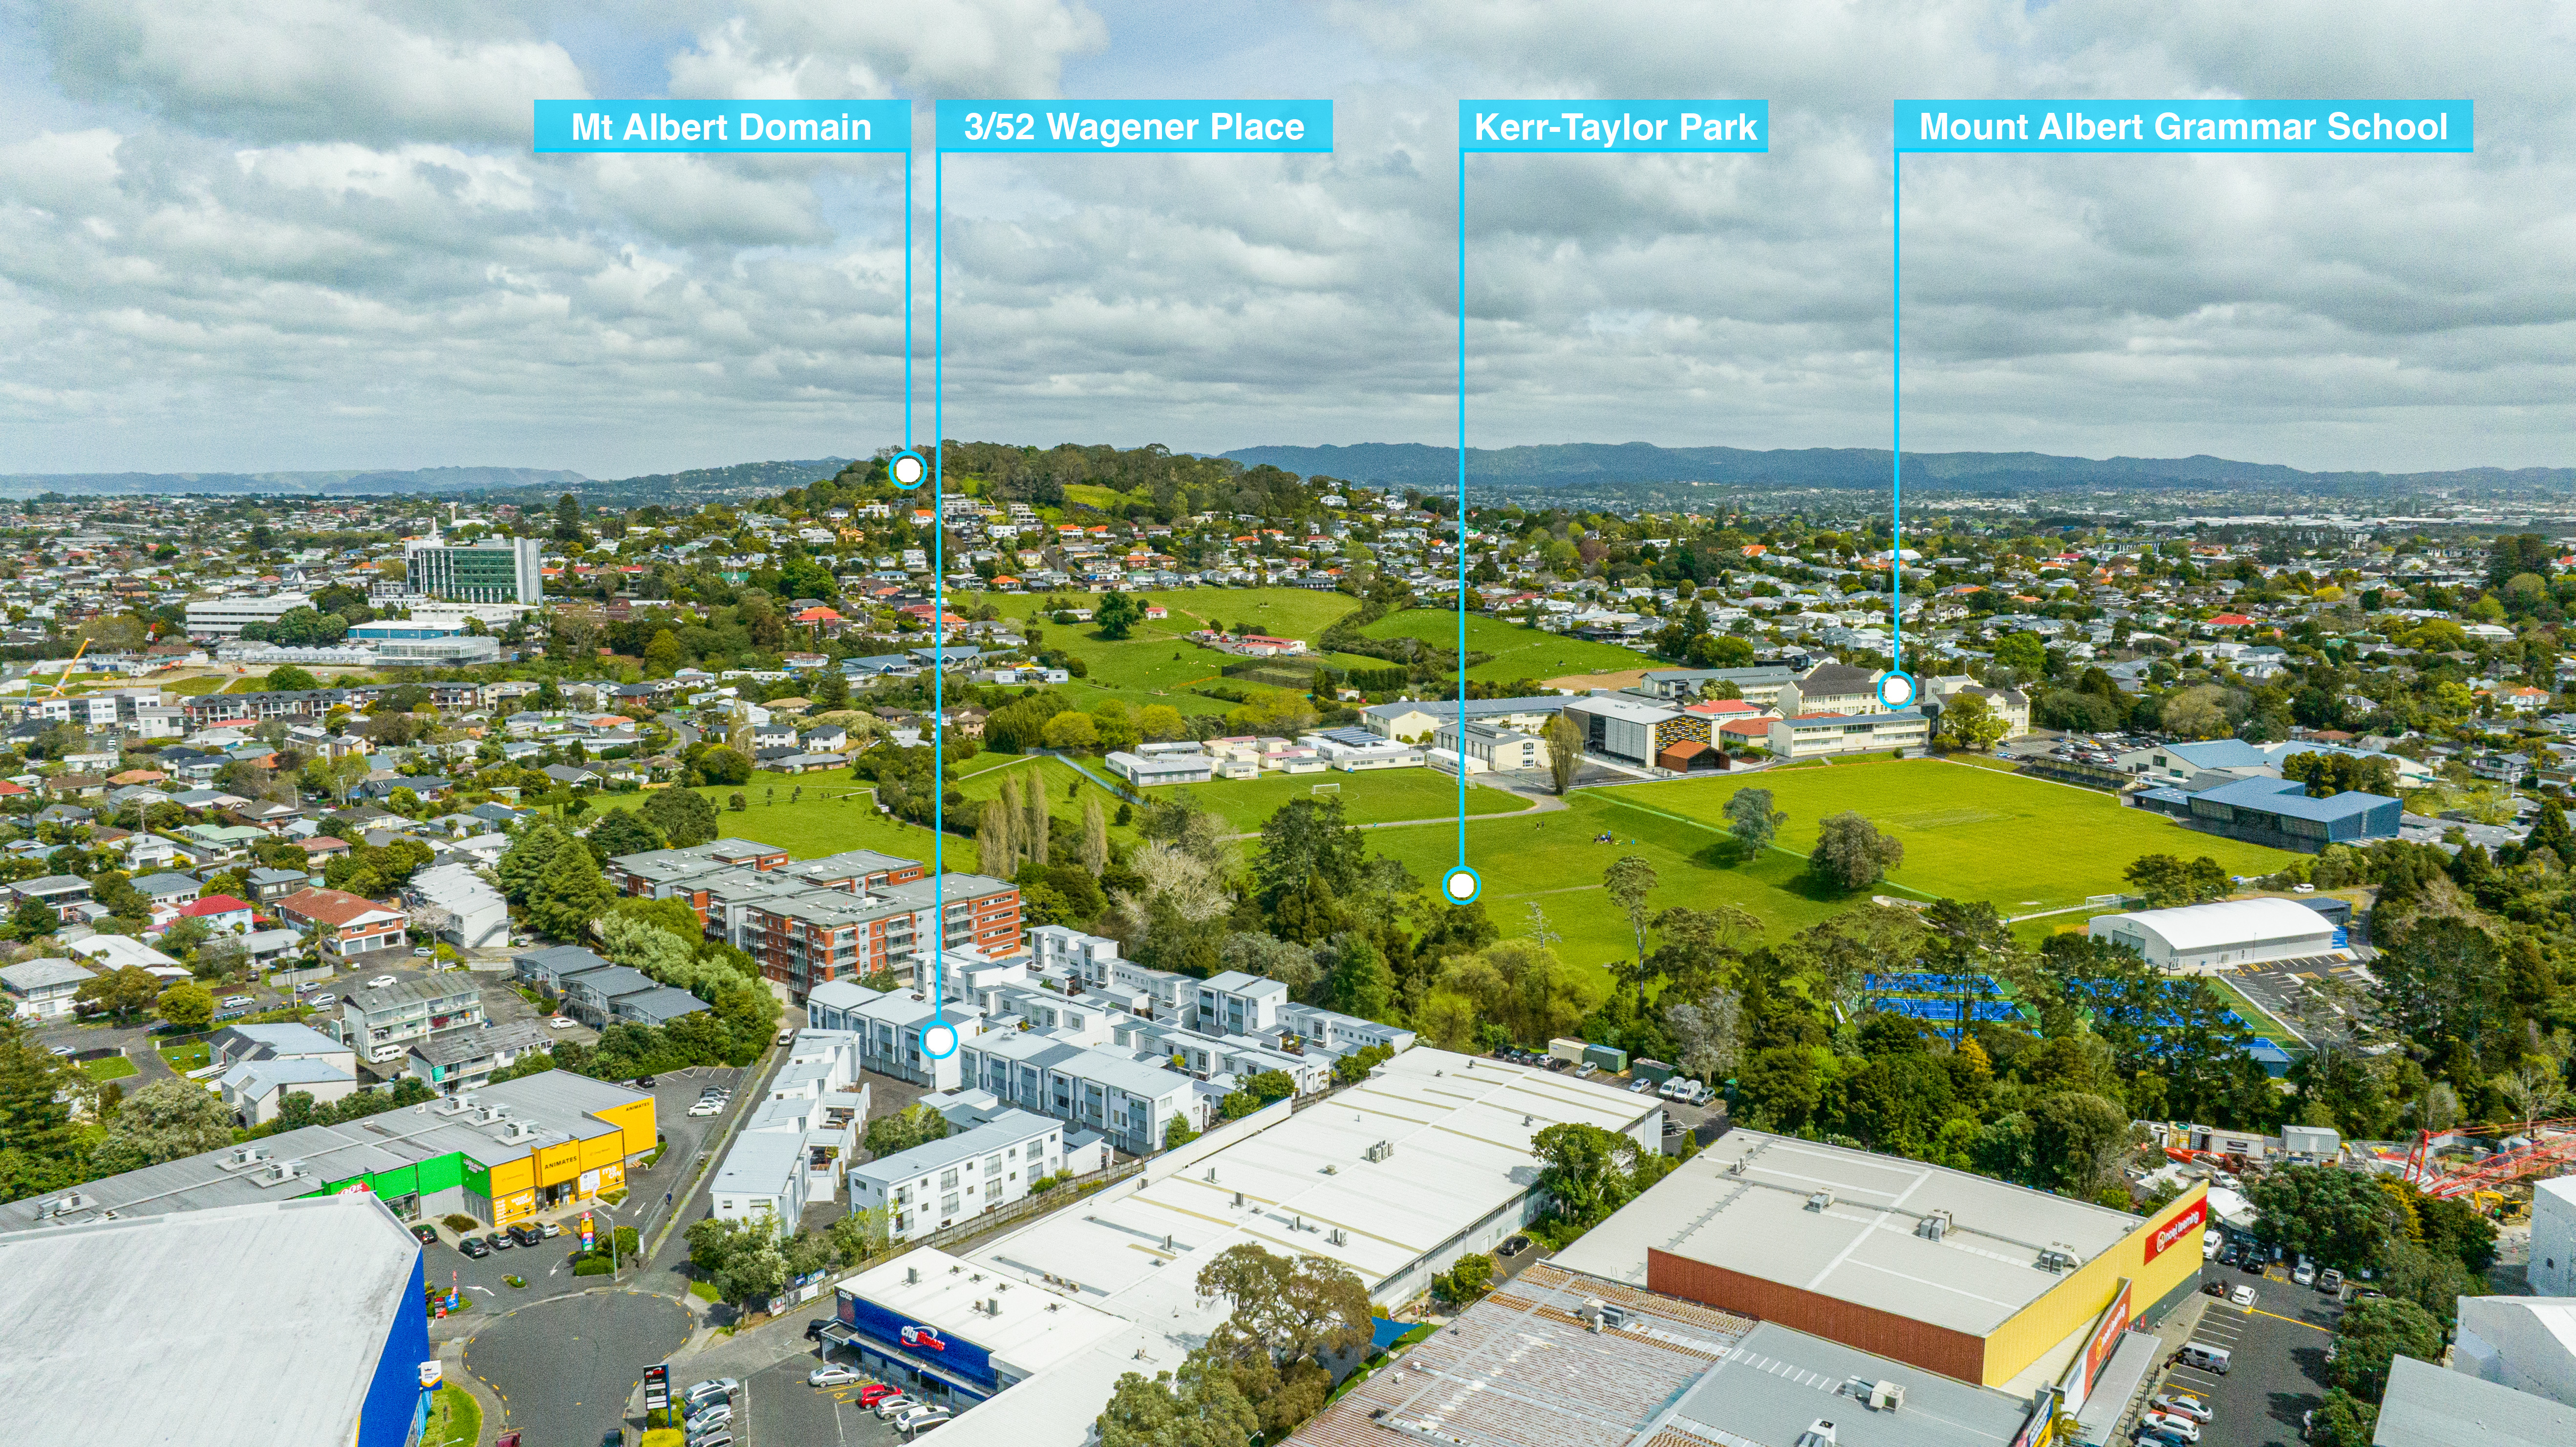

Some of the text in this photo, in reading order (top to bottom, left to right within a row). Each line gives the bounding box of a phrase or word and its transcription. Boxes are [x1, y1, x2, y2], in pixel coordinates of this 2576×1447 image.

[625, 1102, 650, 1111] ANIMATES
[544, 1156, 577, 1170] ANIMATES
[2165, 1224, 2177, 1242] noel
[839, 1290, 852, 1301] axis
